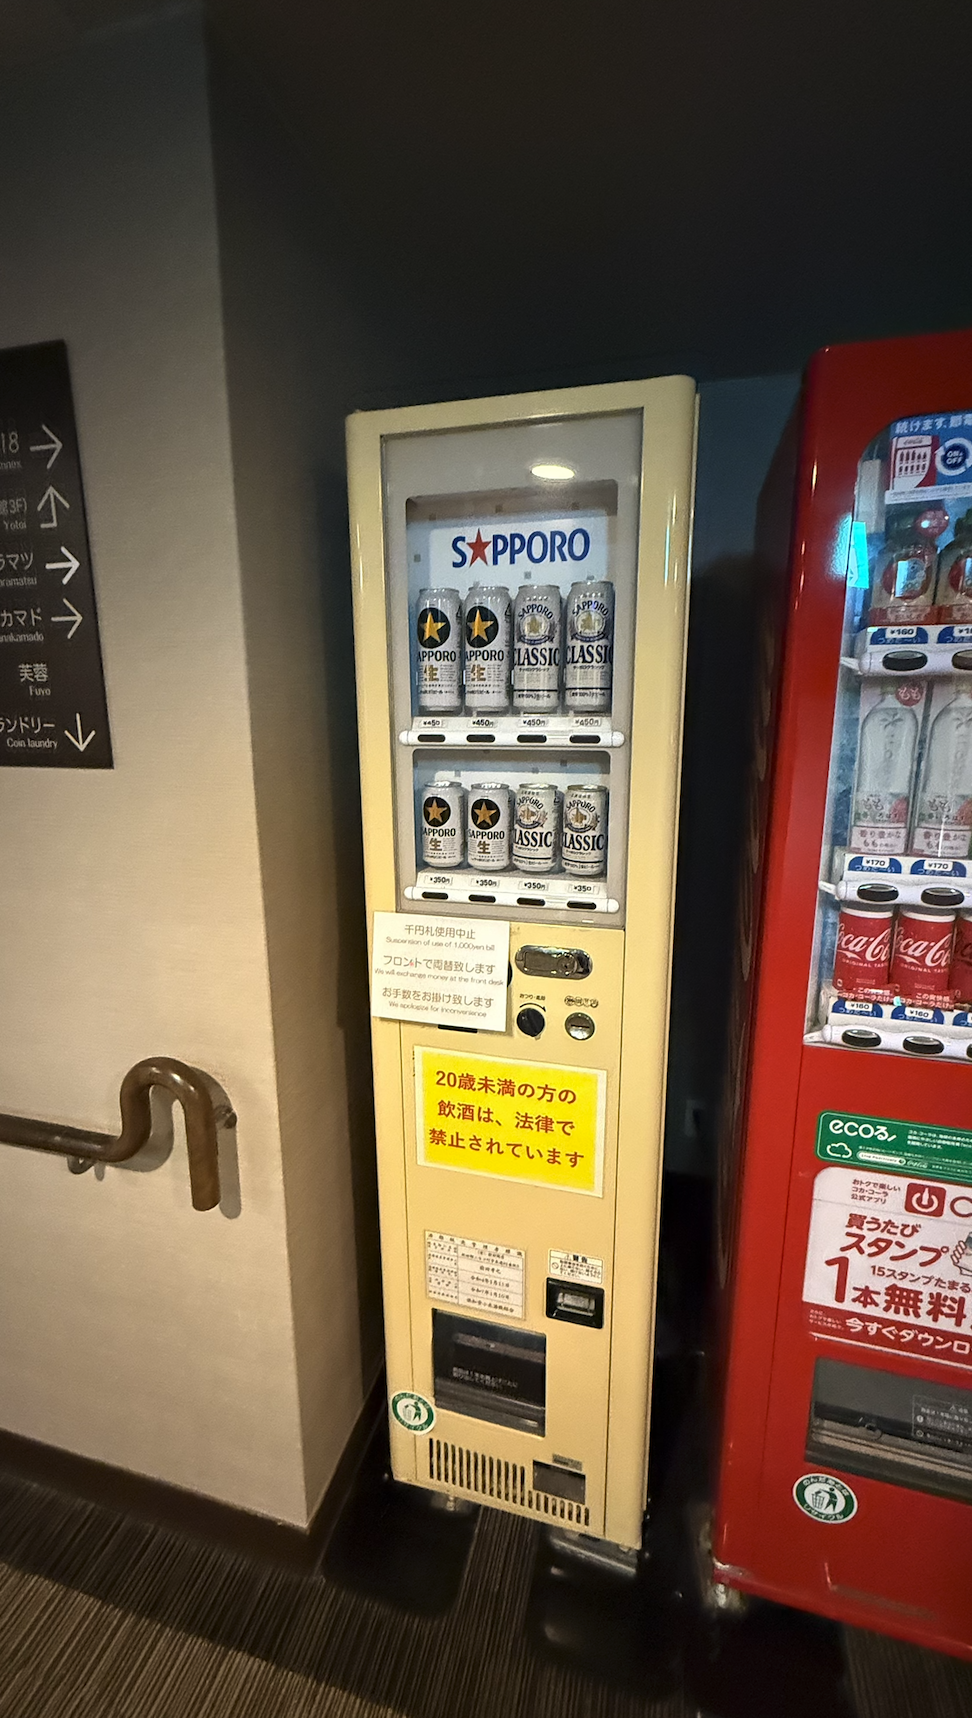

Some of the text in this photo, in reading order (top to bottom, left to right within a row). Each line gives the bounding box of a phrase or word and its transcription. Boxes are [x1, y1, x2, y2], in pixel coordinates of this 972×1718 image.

[429, 838, 442, 851] 生
[477, 841, 491, 854] 生
[928, 862, 949, 870] ¥170
[404, 924, 476, 939] 千円札使用中止
[383, 955, 496, 975] フロントで両替致します
[382, 987, 494, 1008] お手数をお掛け致します
[435, 1070, 577, 1105] 20歳未満の方の
[437, 1099, 576, 1136] 飲酒は、法律で
[429, 1128, 584, 1168] 禁止されています
[851, 1194, 887, 1205] 公式アプリ
[845, 1213, 922, 1238] 買うたび
[840, 1231, 950, 1267] スタンプ
[845, 1317, 970, 1355] 今すぐダウンロ
